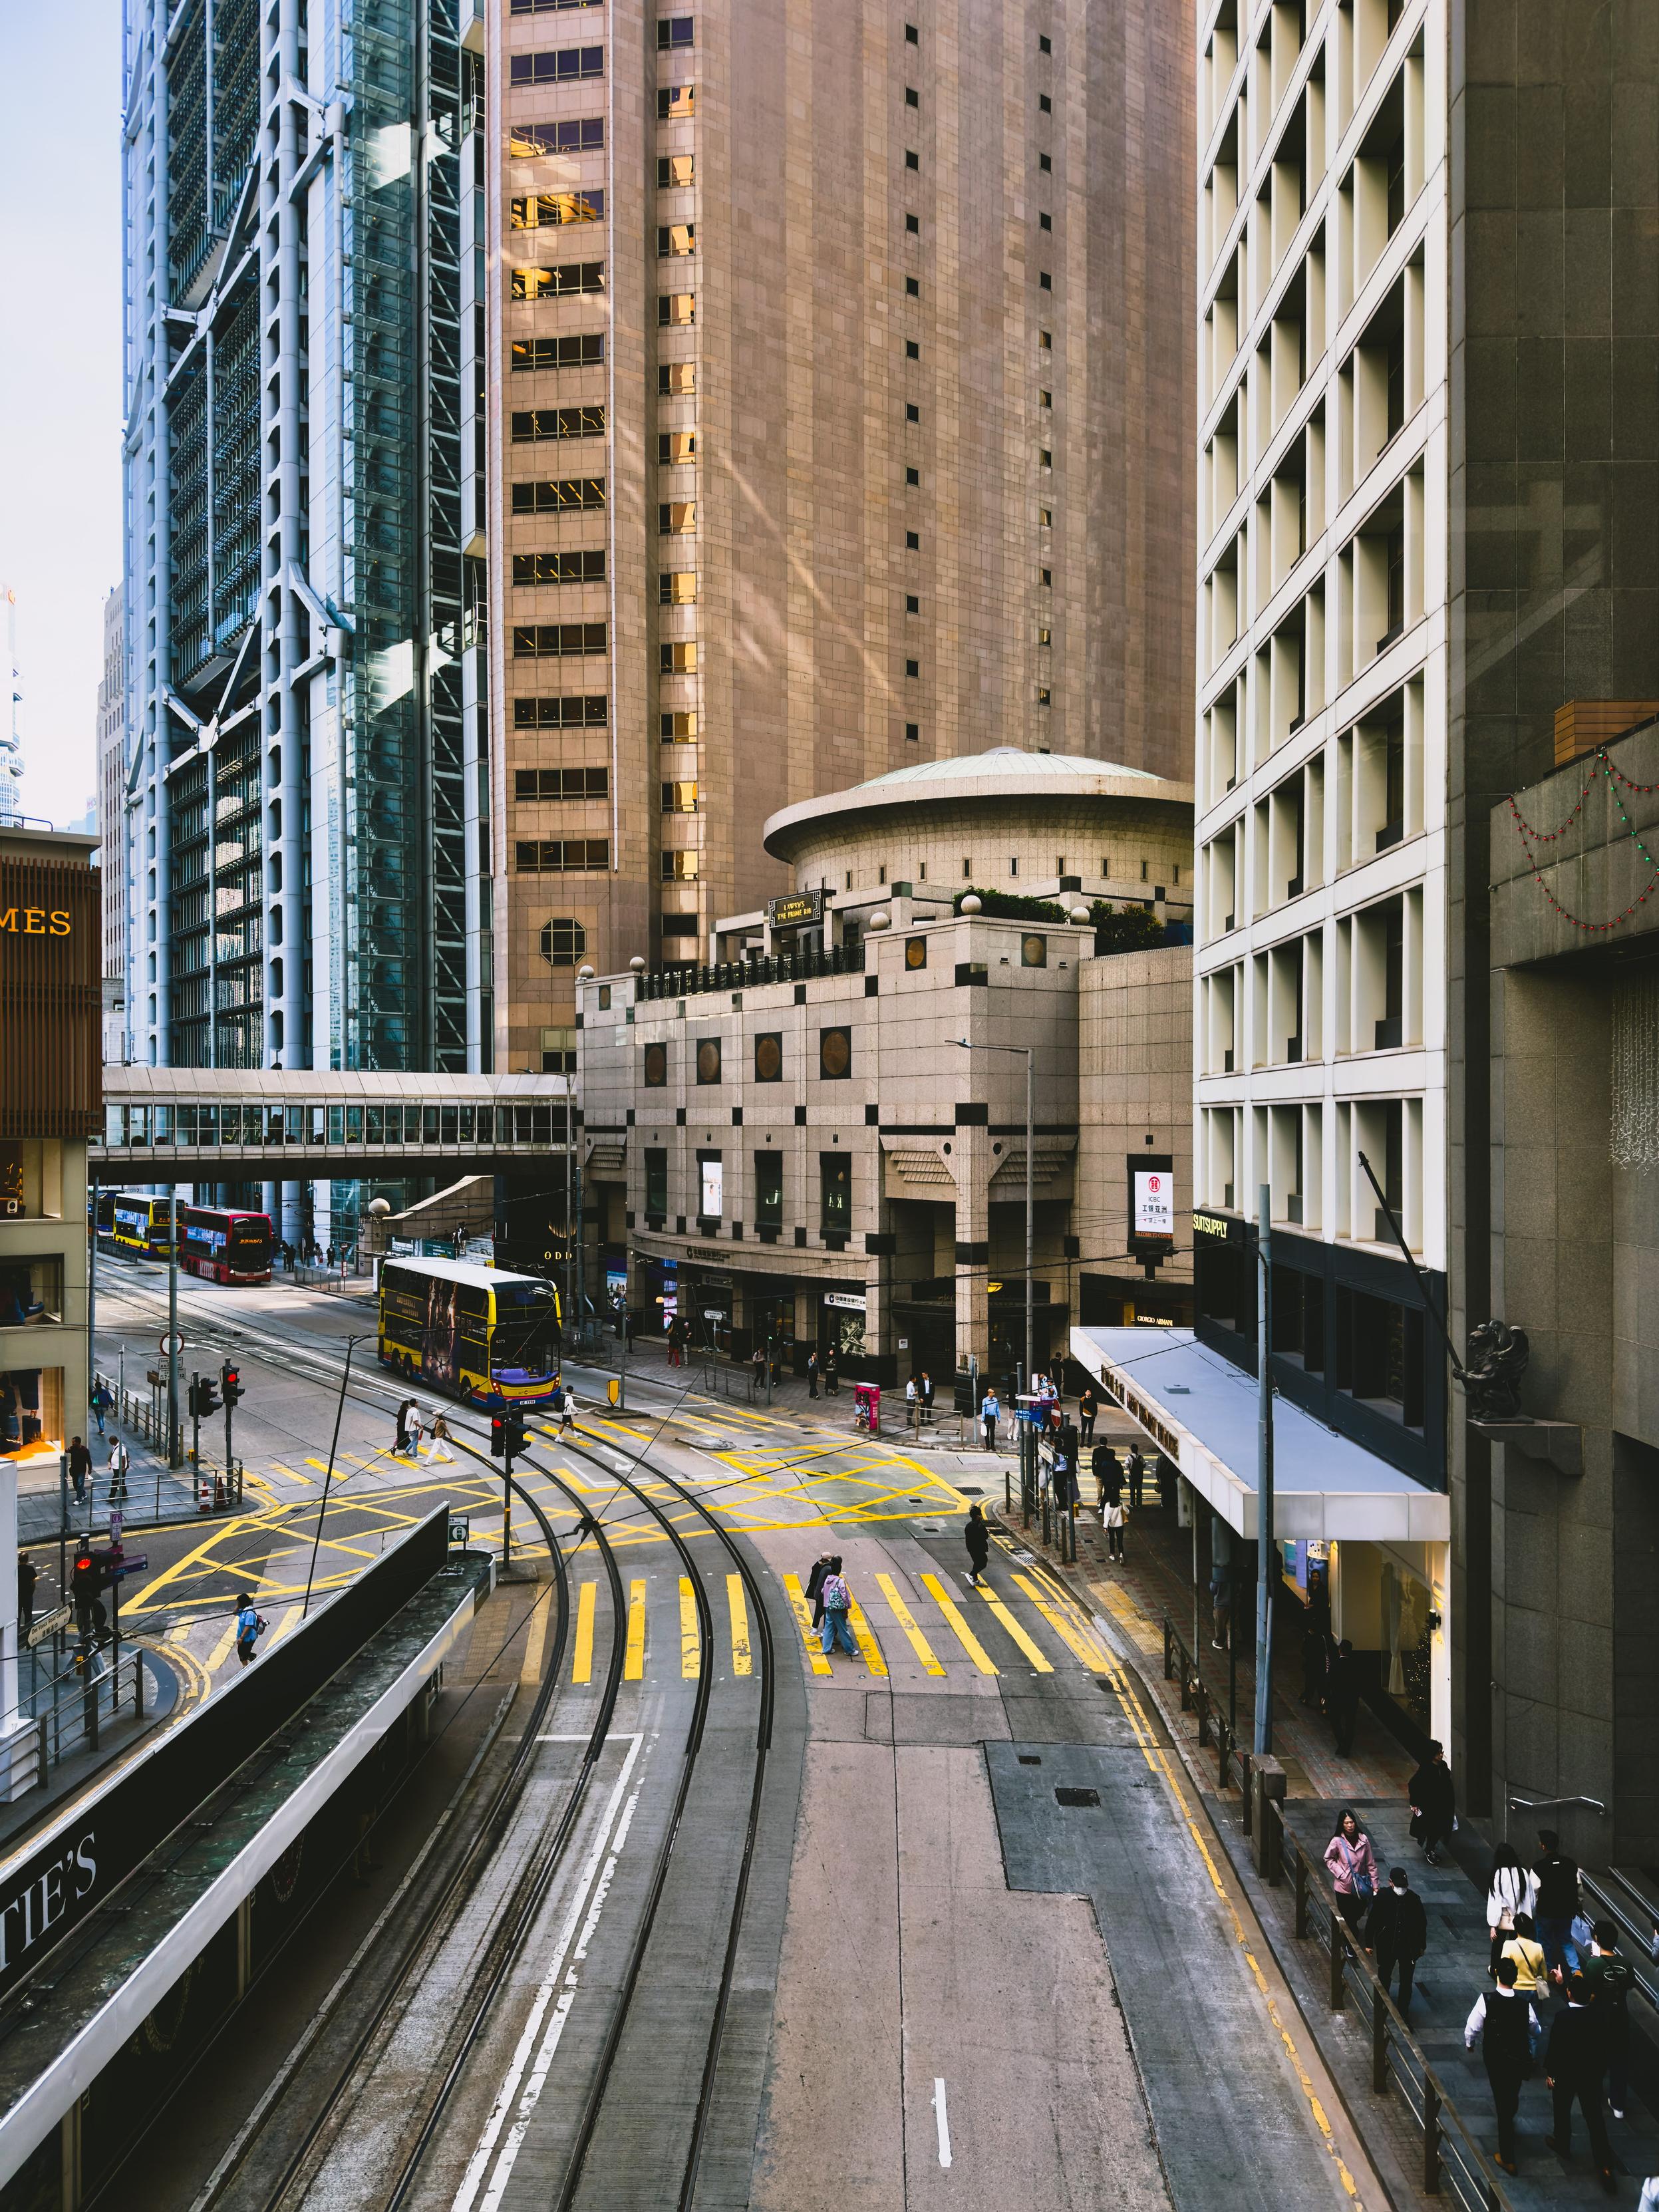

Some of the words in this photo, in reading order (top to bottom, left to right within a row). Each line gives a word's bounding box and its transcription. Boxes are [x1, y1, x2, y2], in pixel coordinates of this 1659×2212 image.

[784, 900, 805, 911] LAWRY'S
[788, 909, 802, 918] PRIME
[1193, 1213, 1227, 1239] SUITSUPPLY
[1156, 1318, 1173, 1327] ARMANI
[38, 1621, 48, 1630] Voeux
[56, 1608, 67, 1619] Central
[0, 1831, 96, 1973] TIE'S
